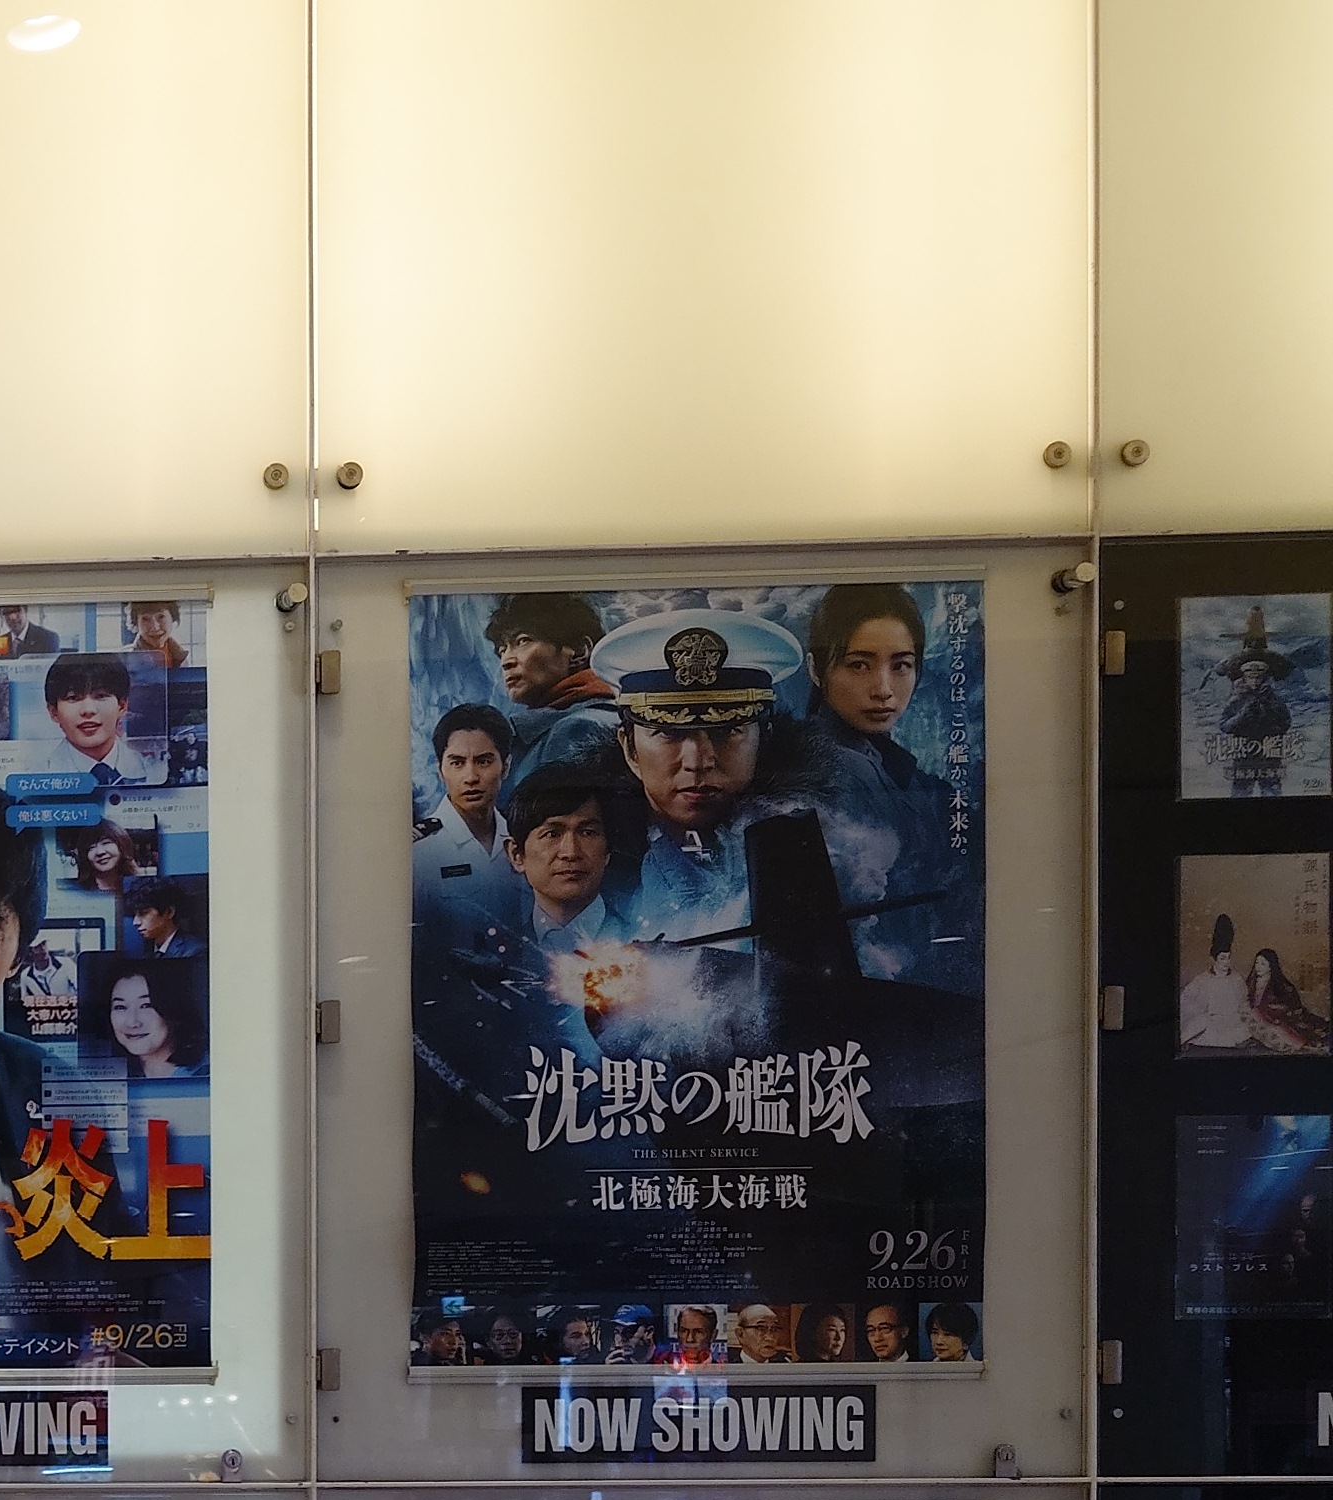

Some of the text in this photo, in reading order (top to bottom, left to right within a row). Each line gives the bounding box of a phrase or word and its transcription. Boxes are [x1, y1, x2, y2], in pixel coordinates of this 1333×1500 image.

[524, 1040, 875, 1152] 沈黙の艦隊
[632, 1147, 760, 1158] THE SILENT SERVICE
[592, 1173, 809, 1211] 北極海大海戦
[865, 1228, 956, 1273] 9.26
[866, 1275, 970, 1290] ROADSHOW
[91, 1323, 173, 1350] #9/26
[534, 1396, 866, 1453] NOW SHOWING
